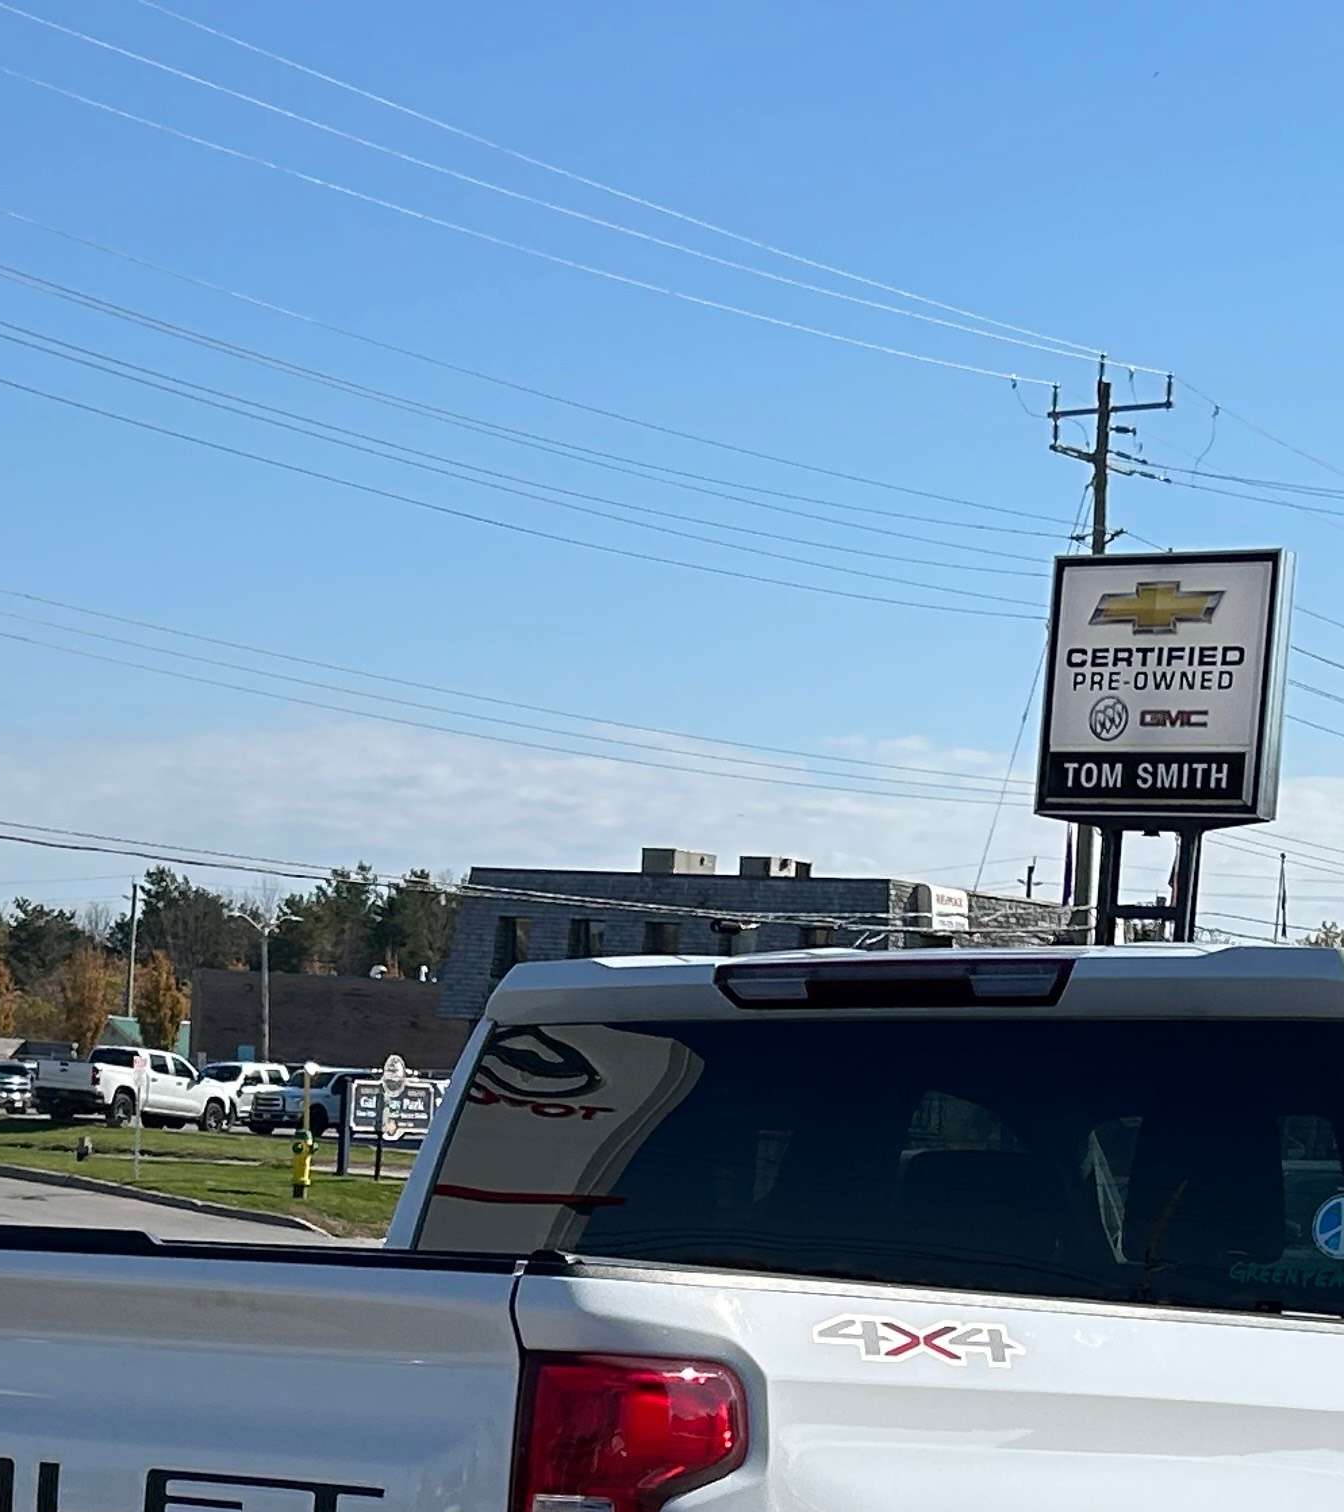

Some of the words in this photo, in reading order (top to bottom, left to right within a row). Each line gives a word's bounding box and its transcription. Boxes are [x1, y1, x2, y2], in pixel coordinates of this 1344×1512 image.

[1066, 646, 1245, 668] CERTIFIED
[1073, 671, 1233, 691] PRE-OWNED
[1139, 710, 1209, 728] GMC
[1064, 763, 1122, 788] TOM
[1136, 763, 1228, 789] SMITH
[402, 1097, 424, 1111] Park
